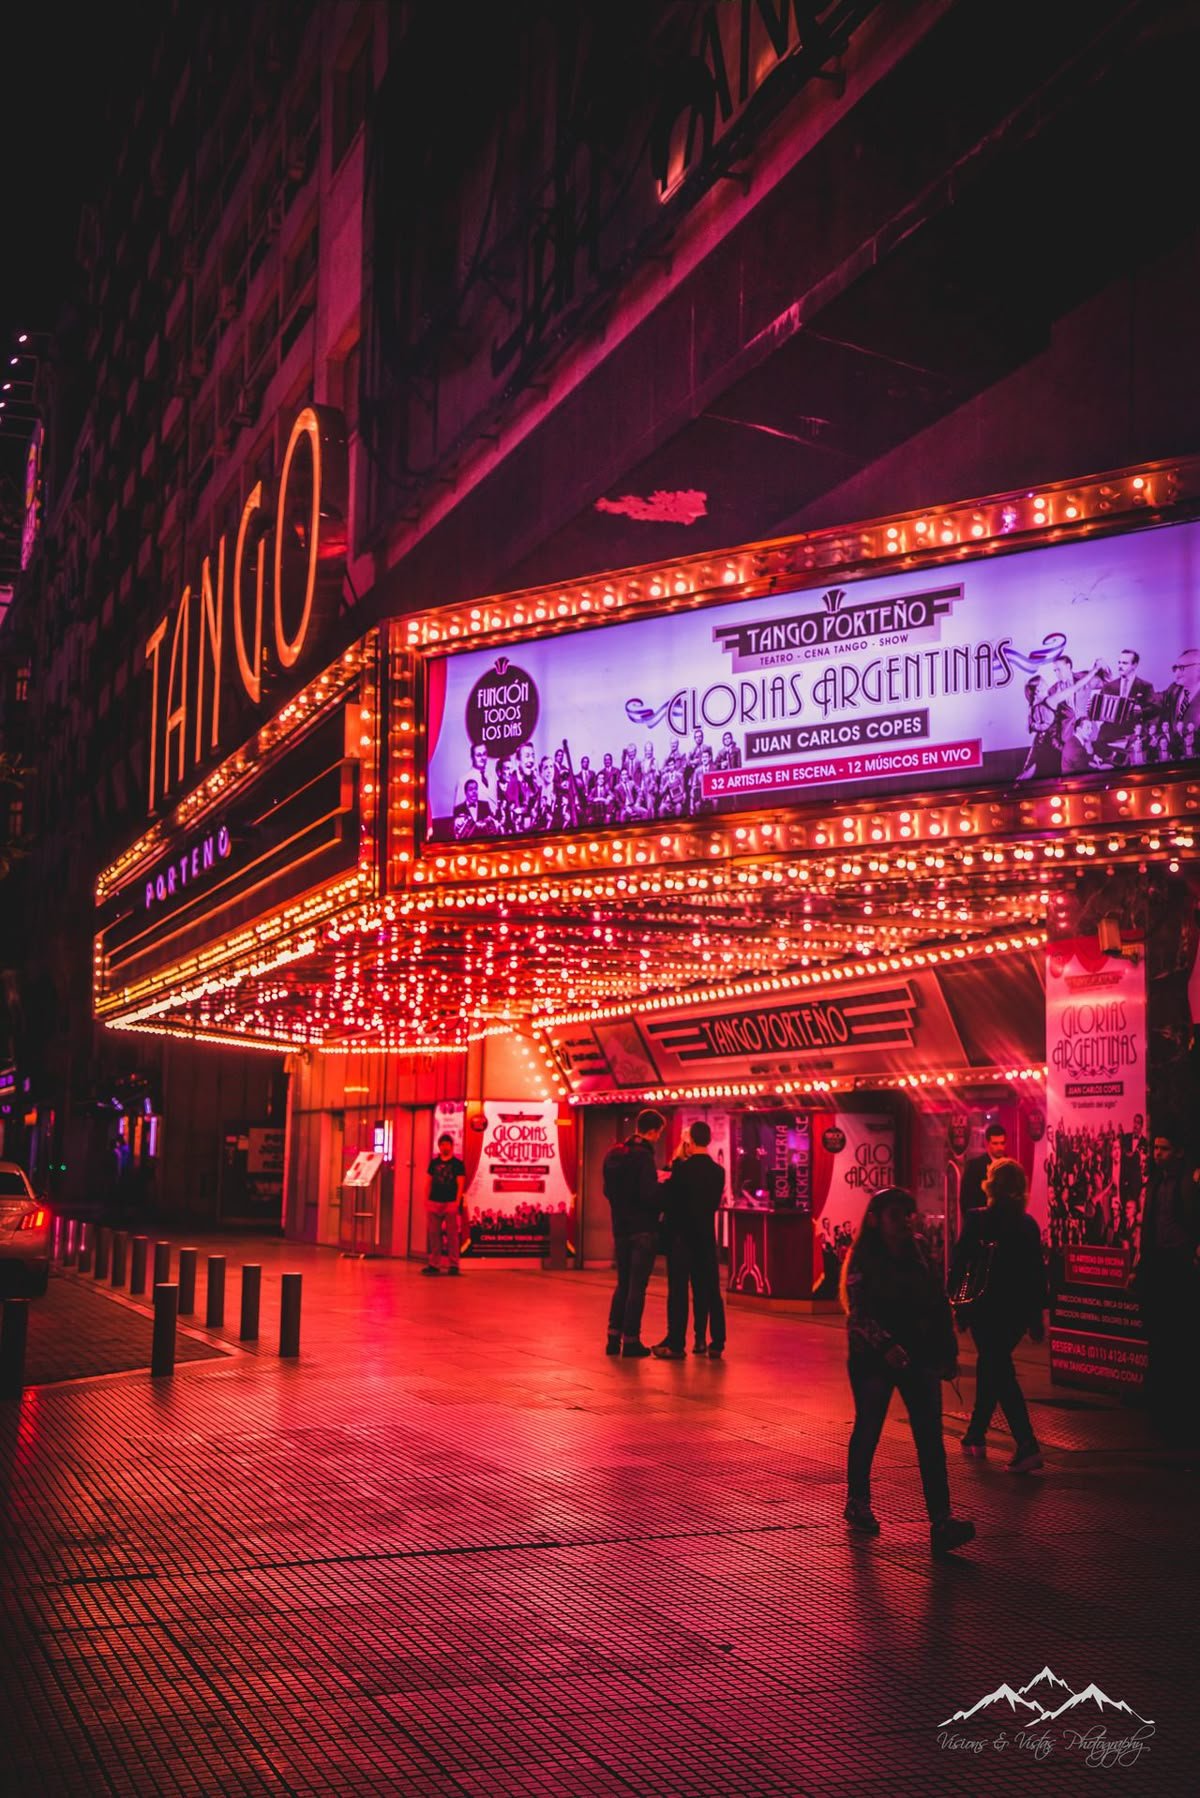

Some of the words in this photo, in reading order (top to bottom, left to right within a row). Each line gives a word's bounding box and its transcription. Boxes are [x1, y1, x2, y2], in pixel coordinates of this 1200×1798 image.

[146, 406, 320, 816] TANGO
[746, 620, 818, 653] TANGO
[823, 600, 927, 641] PORTEÑO
[760, 652, 793, 665] TEATRO
[804, 646, 830, 659] CENA
[834, 640, 868, 655] TANGO
[879, 634, 909, 647] SHOW
[477, 679, 529, 708] FUNCIÓN
[667, 672, 803, 737] GLORIAS
[812, 639, 1013, 721] ARGENTINAS
[484, 705, 521, 723] TODOS
[482, 725, 501, 741] LOS
[752, 735, 791, 754] JUAN
[798, 726, 861, 749] CARLOS
[866, 717, 922, 740] COPES
[710, 777, 725, 790] 32
[726, 770, 775, 788] ARTISTAS
[776, 769, 790, 783] EN
[791, 764, 837, 781] ESCENA
[847, 761, 862, 774] 12
[864, 752, 920, 772] MÚSICOS
[922, 751, 939, 765] EN
[941, 747, 972, 763] VIVO
[701, 1017, 763, 1054] TANGO
[759, 1002, 849, 1050] PORTEÑO
[1062, 1001, 1127, 1039] GLORIAS
[1052, 1034, 1138, 1073] ARGENTINAS
[484, 1142, 556, 1161] ARGENTINAS
[493, 1125, 548, 1142] GLORIAS
[1051, 1340, 1087, 1356] RESERVAS
